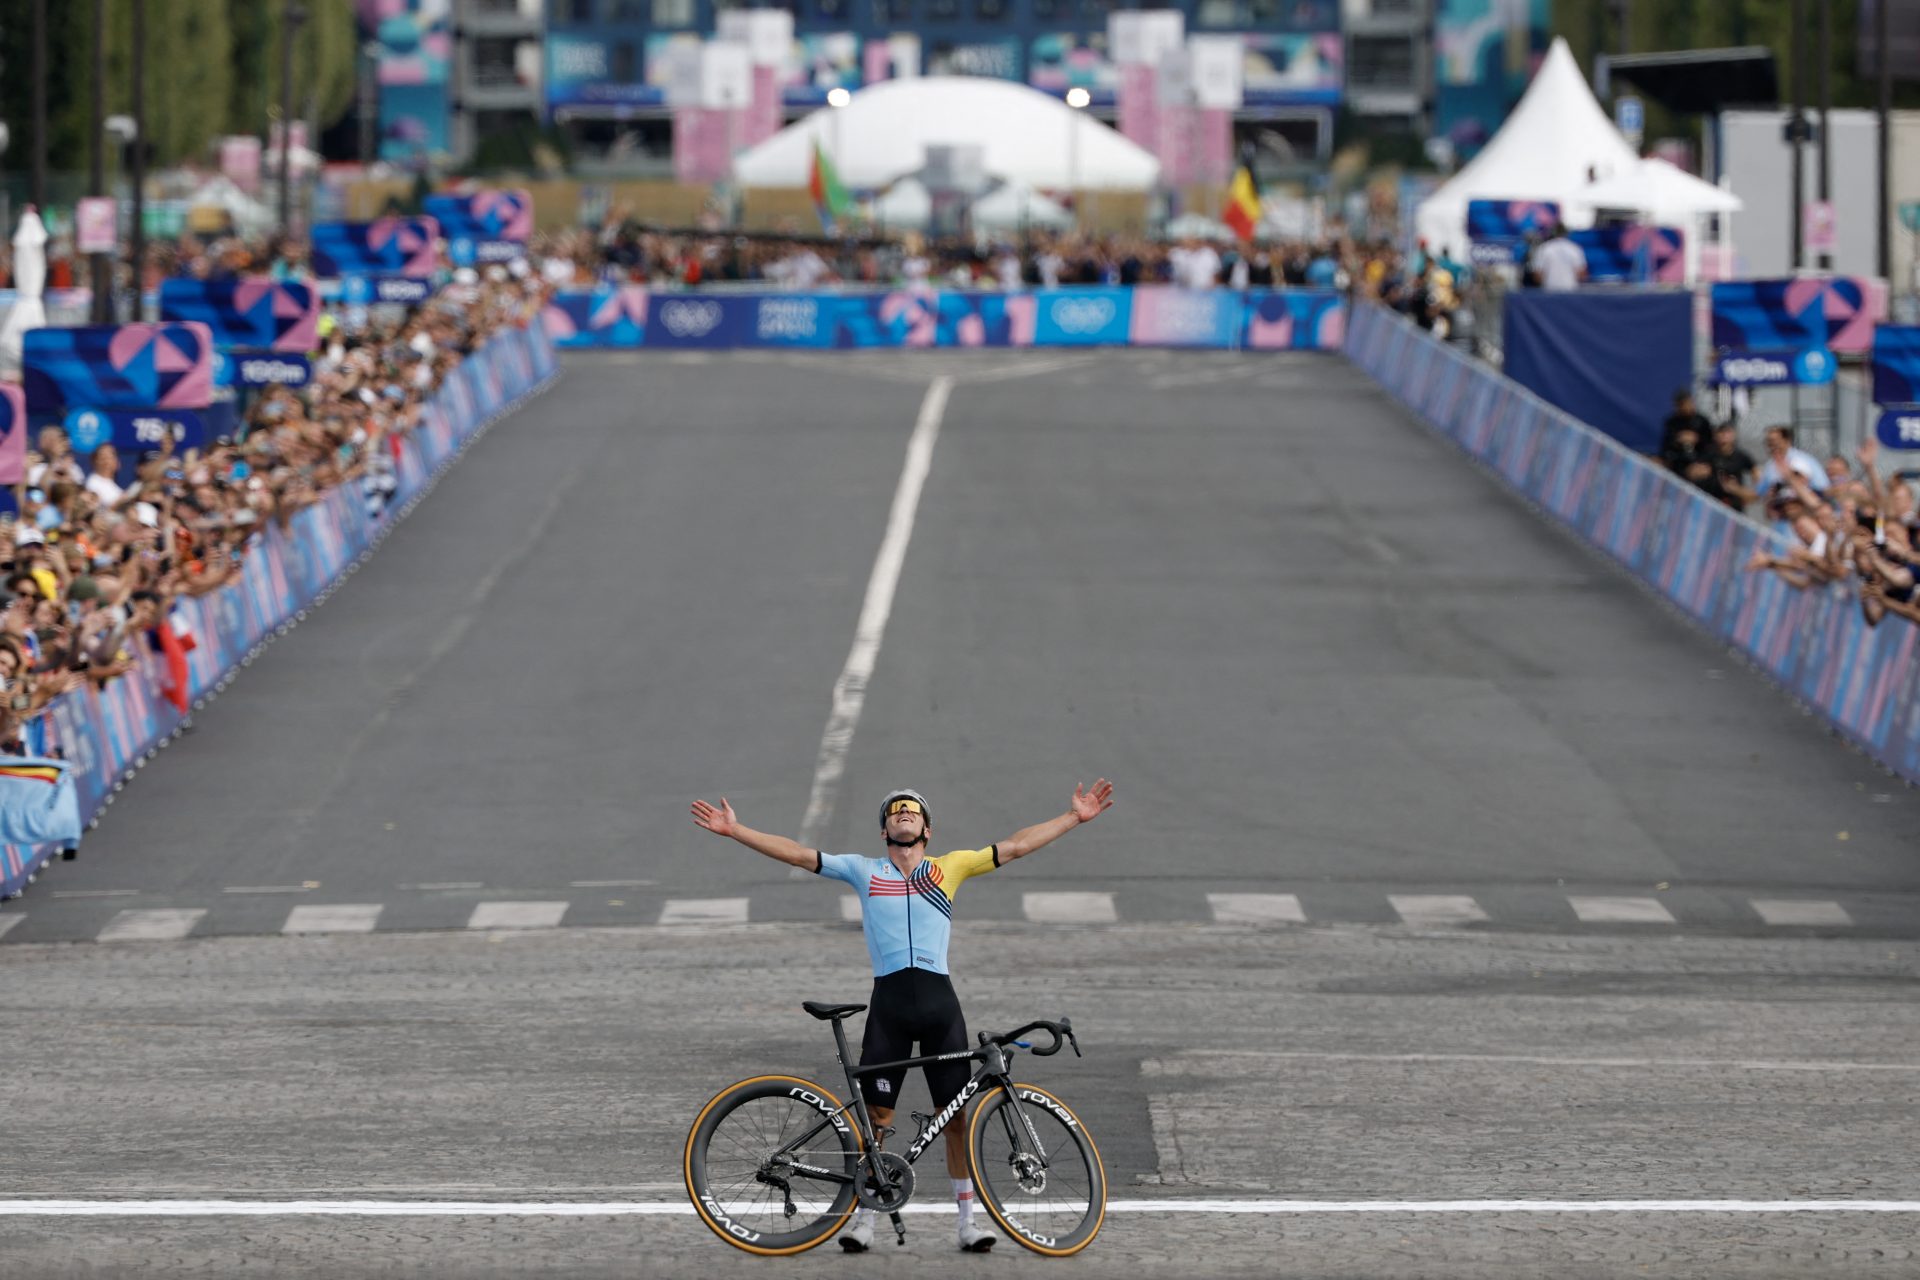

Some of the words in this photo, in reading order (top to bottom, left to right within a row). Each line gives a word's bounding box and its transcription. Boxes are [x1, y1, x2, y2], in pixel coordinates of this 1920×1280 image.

[240, 360, 306, 383] 100m
[1721, 358, 1789, 382] 100m
[910, 1076, 979, 1160] S-WORKS
[1022, 1090, 1077, 1126] roval
[700, 1195, 761, 1242] roval
